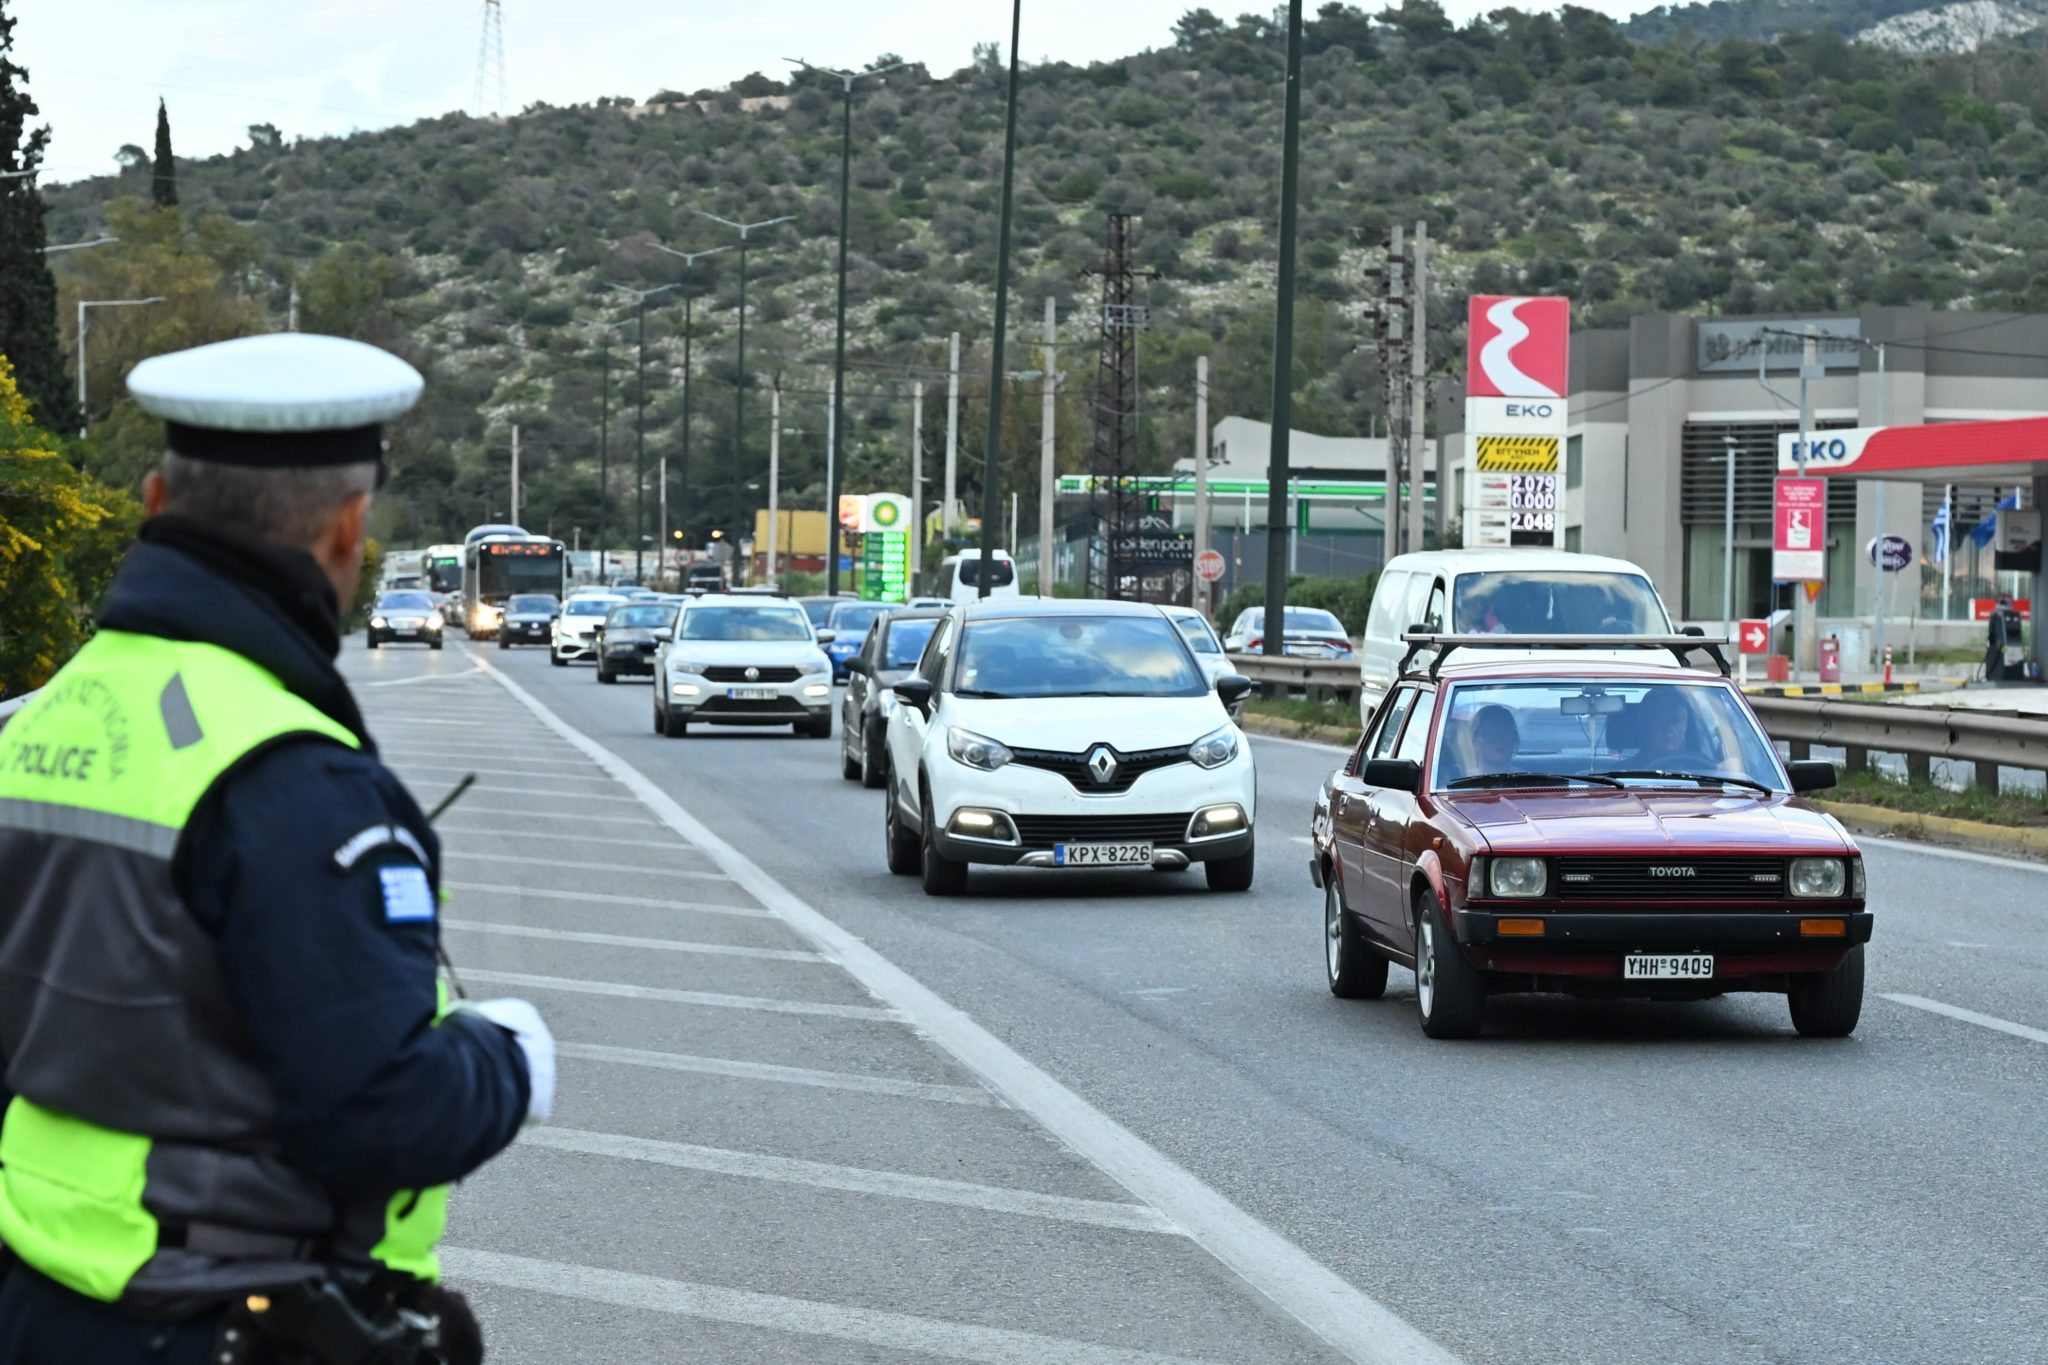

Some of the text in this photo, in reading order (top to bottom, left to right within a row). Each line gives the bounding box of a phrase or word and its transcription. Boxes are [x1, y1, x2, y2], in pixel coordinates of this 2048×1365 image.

[1506, 404, 1553, 418] EKO
[1792, 439, 1846, 462] EKO
[1512, 475, 1555, 492] 2.079
[1512, 492, 1555, 509] 0.000
[1511, 512, 1554, 530] 2.048
[1161, 534, 1193, 553] point
[1196, 559, 1223, 573] STOP
[11, 743, 98, 781] POLICE
[1649, 866, 1696, 877] TOYOTA
